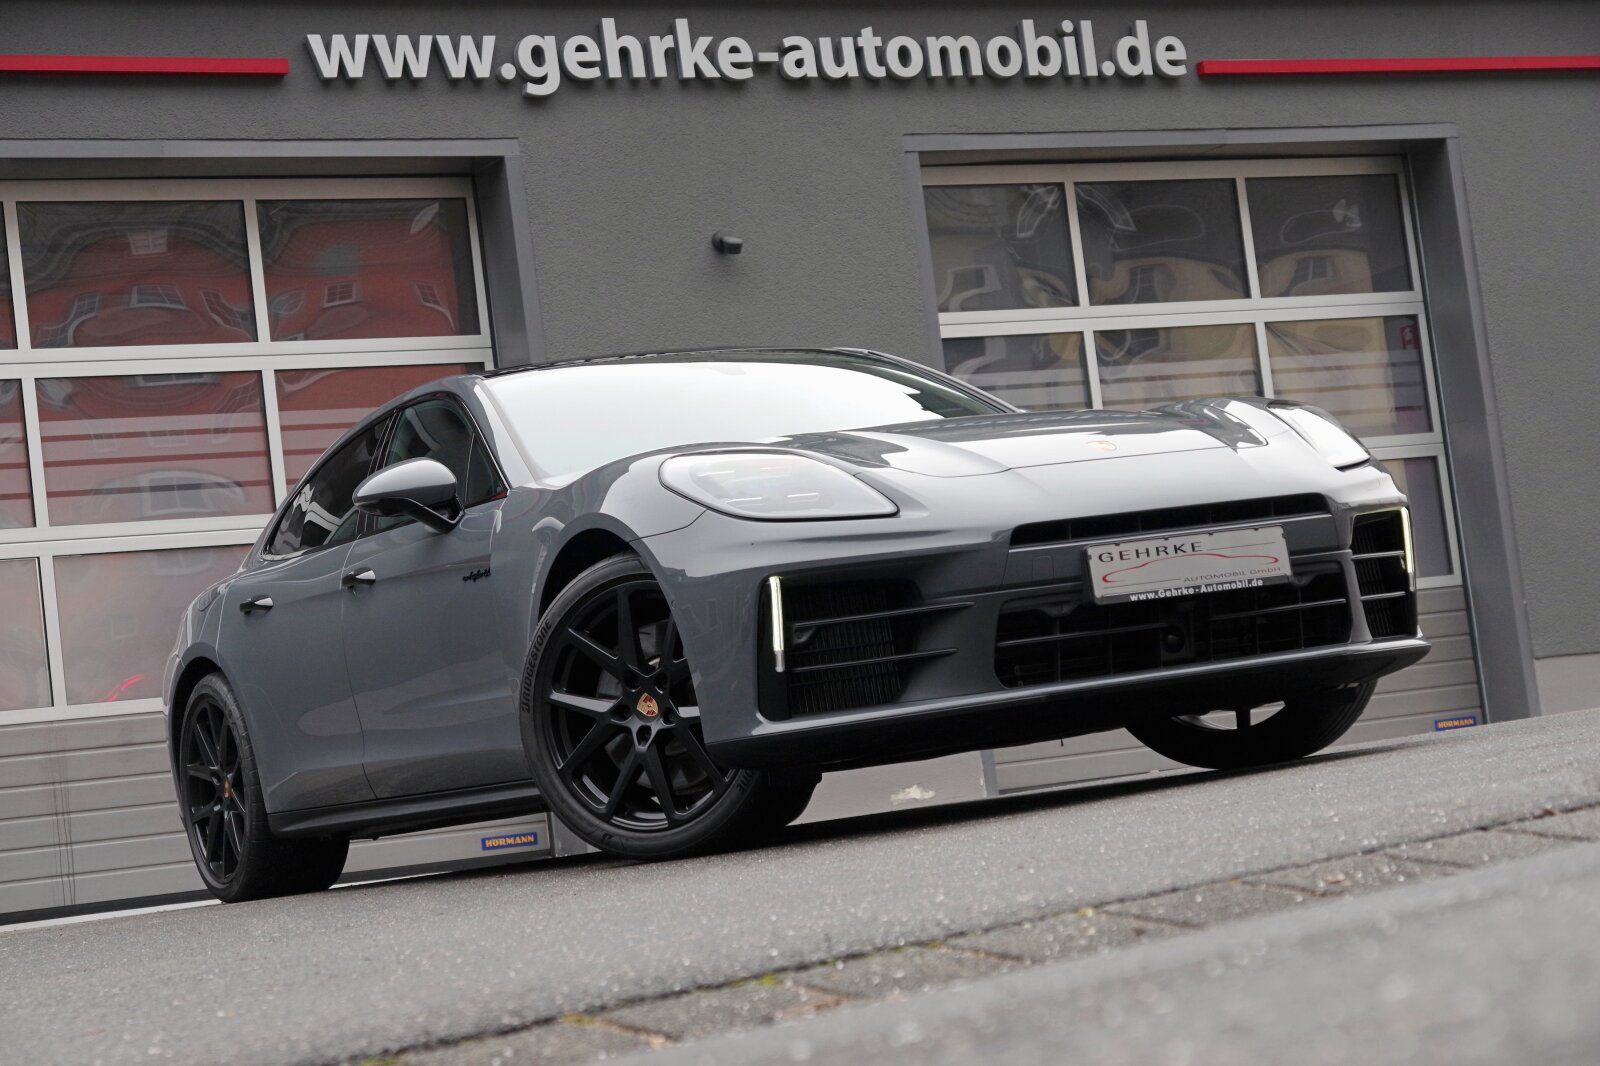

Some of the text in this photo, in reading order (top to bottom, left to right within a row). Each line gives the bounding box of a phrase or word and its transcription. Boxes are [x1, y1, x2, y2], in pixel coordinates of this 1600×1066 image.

[305, 17, 1187, 97] www.gehrke-automobil.de
[1098, 541, 1203, 563] GEHRKE
[1183, 566, 1281, 583] AUTOMOBIL GmbH
[521, 619, 552, 714] BRIDGESTONE
